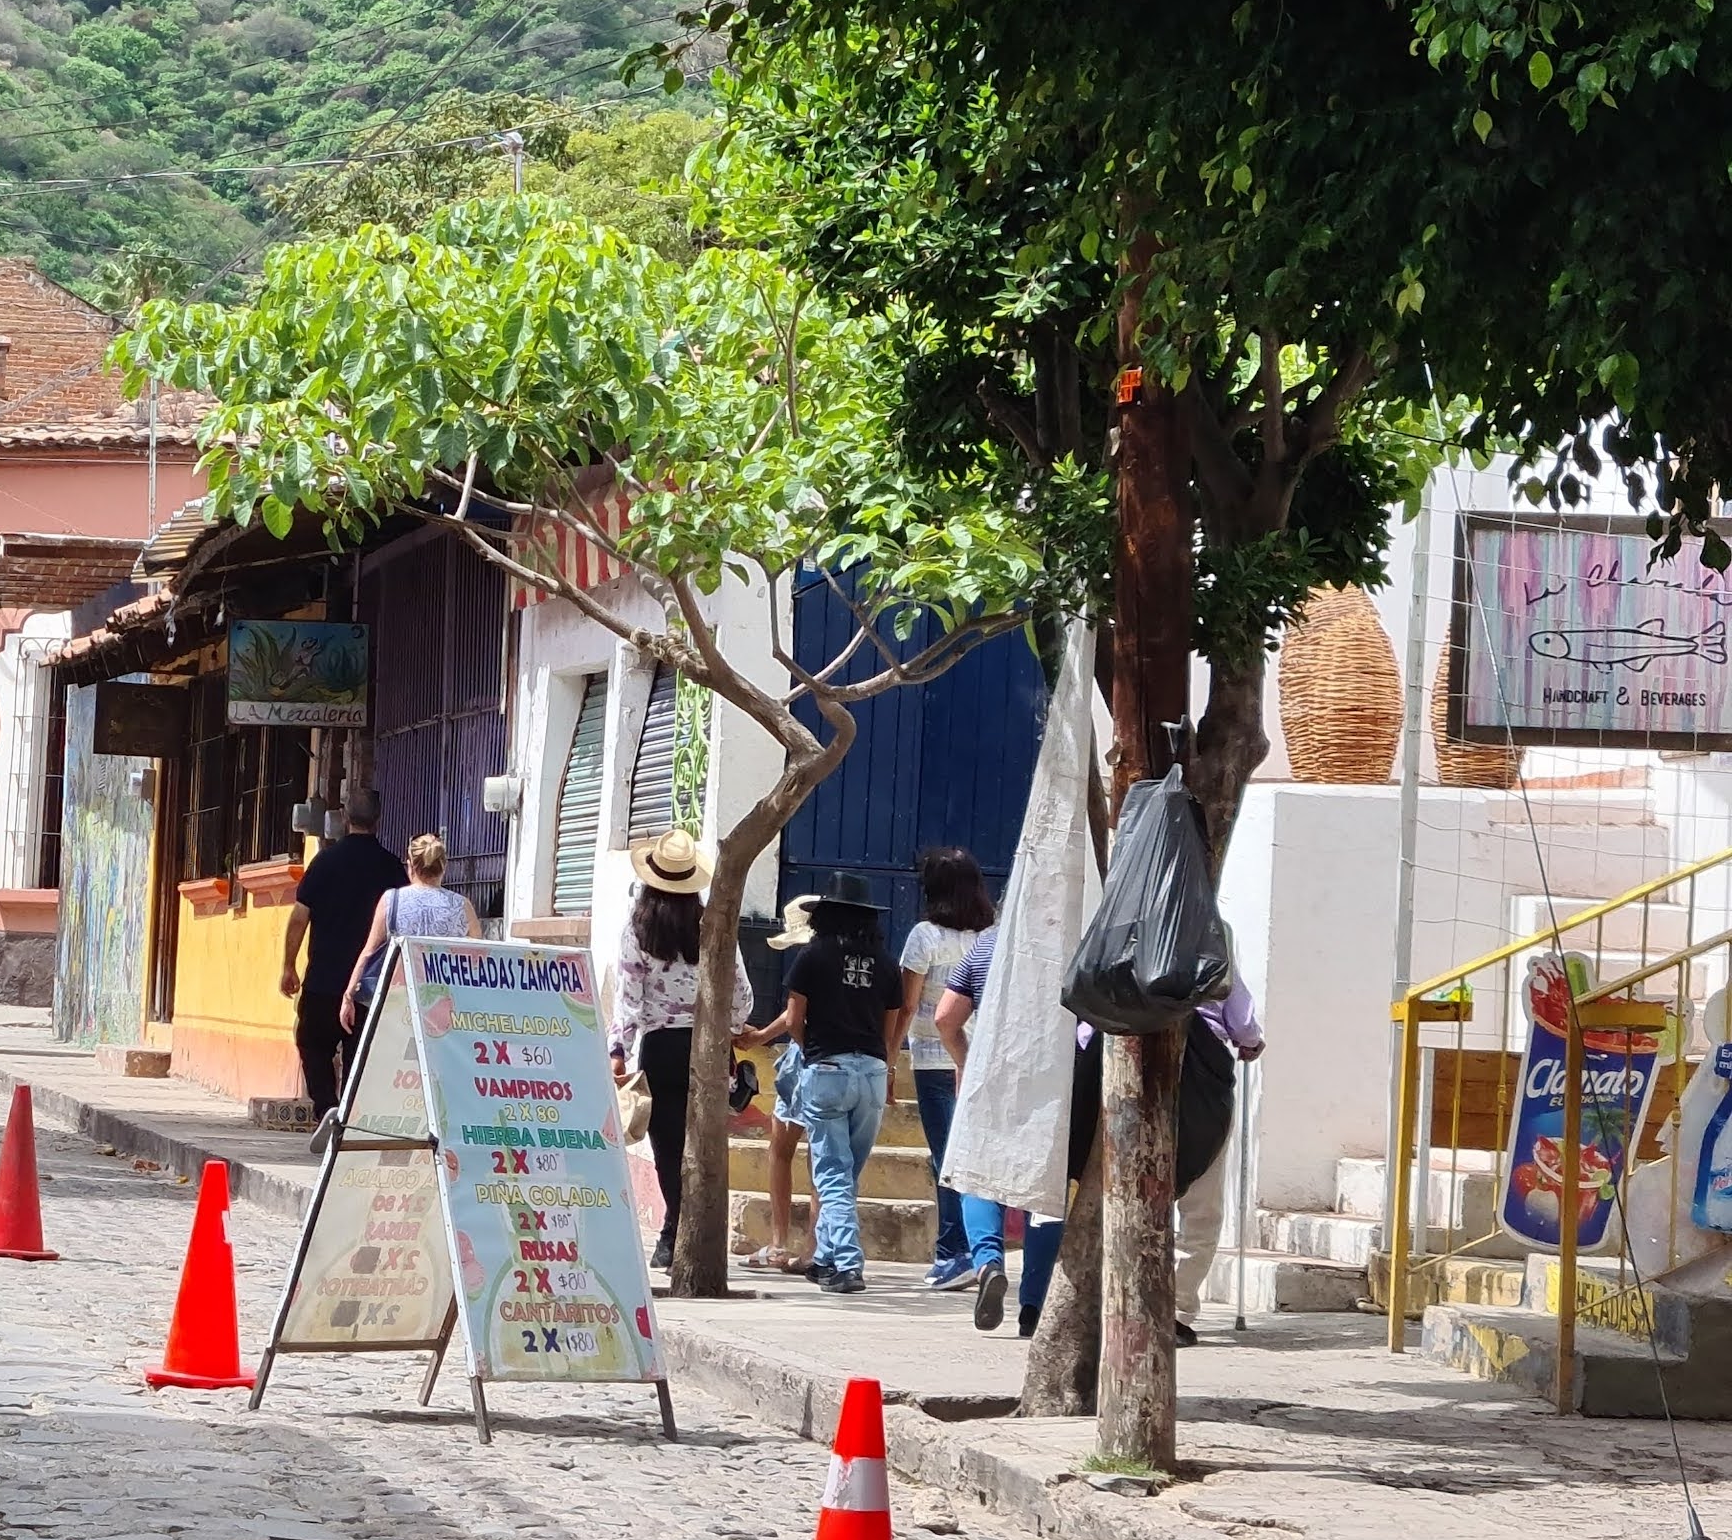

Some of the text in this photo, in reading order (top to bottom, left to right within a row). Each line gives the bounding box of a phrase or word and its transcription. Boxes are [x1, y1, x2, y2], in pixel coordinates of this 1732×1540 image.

[1616, 686, 1630, 705] &
[1641, 689, 1707, 706] BEVERAGES
[422, 952, 584, 993] MICHELADAS ZAMORA
[450, 1010, 571, 1037] MICHELADAS
[473, 1040, 553, 1066] 2 X $60
[474, 1076, 573, 1102] VAMPIROS
[504, 1102, 560, 1123] 2 X 80
[462, 1124, 607, 1151] HIERBA BUENA
[491, 1151, 507, 1174] 2
[511, 1149, 530, 1175] X
[475, 1180, 612, 1208] PIÑA COLADA
[518, 1212, 531, 1230] 2
[533, 1211, 548, 1230] X
[519, 1240, 578, 1262] RUSAS
[514, 1267, 587, 1294] 2 X $80
[500, 1300, 620, 1325] CANTARITOS
[522, 1330, 538, 1353] 2
[542, 1327, 561, 1353] X
